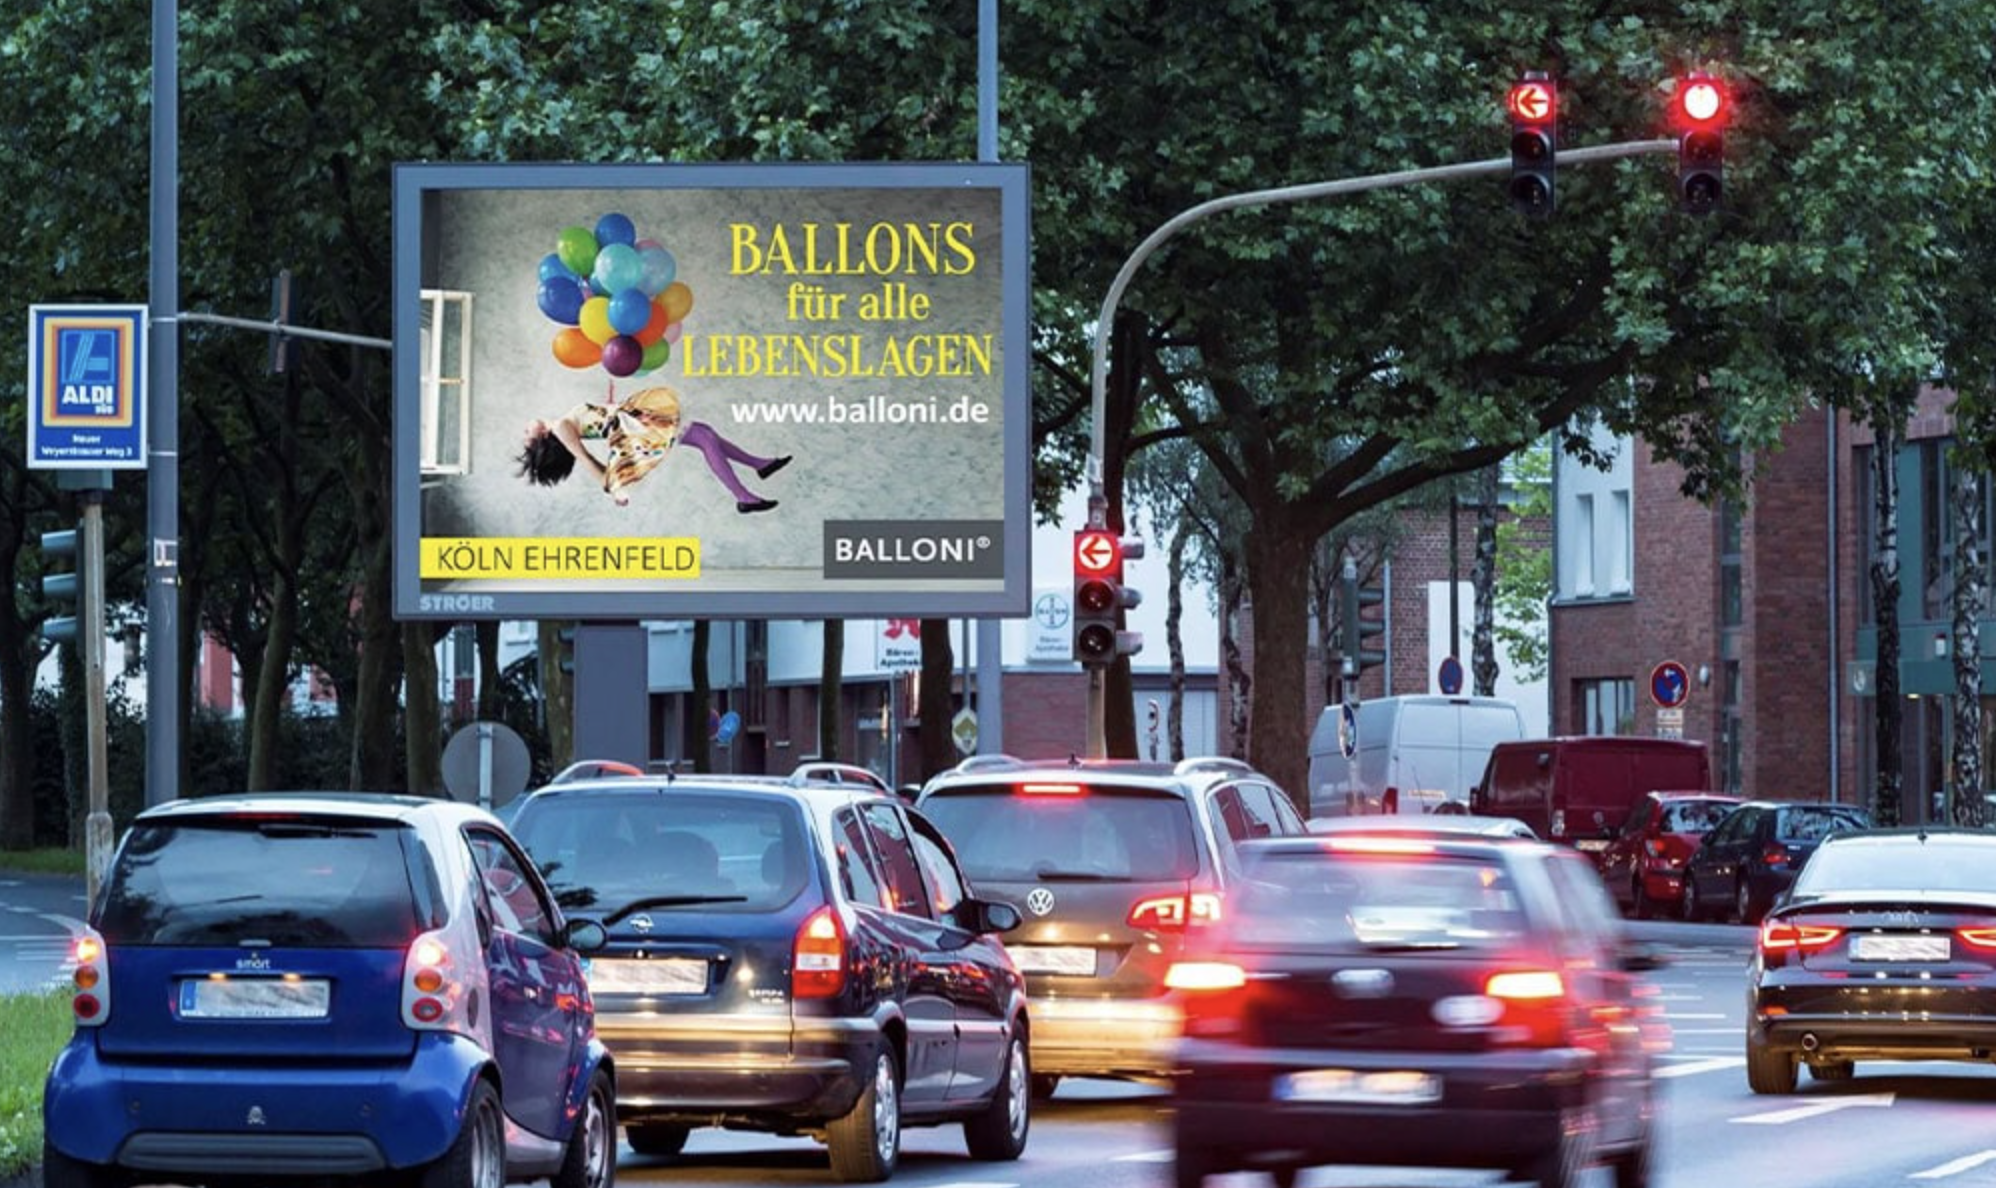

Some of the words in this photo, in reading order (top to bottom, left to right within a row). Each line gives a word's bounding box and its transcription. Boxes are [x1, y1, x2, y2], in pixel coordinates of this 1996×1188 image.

[729, 222, 977, 276] BALLONS
[787, 282, 846, 321] für
[858, 282, 931, 321] alle
[682, 333, 993, 378] LEBENSLAGEN
[61, 385, 114, 404] ALDI
[730, 395, 990, 424] www.balloni.de
[438, 544, 513, 571] KÖLN
[524, 546, 695, 571] EHRENFELD
[420, 593, 495, 612] STRÖER
[880, 658, 921, 668] Apothek
